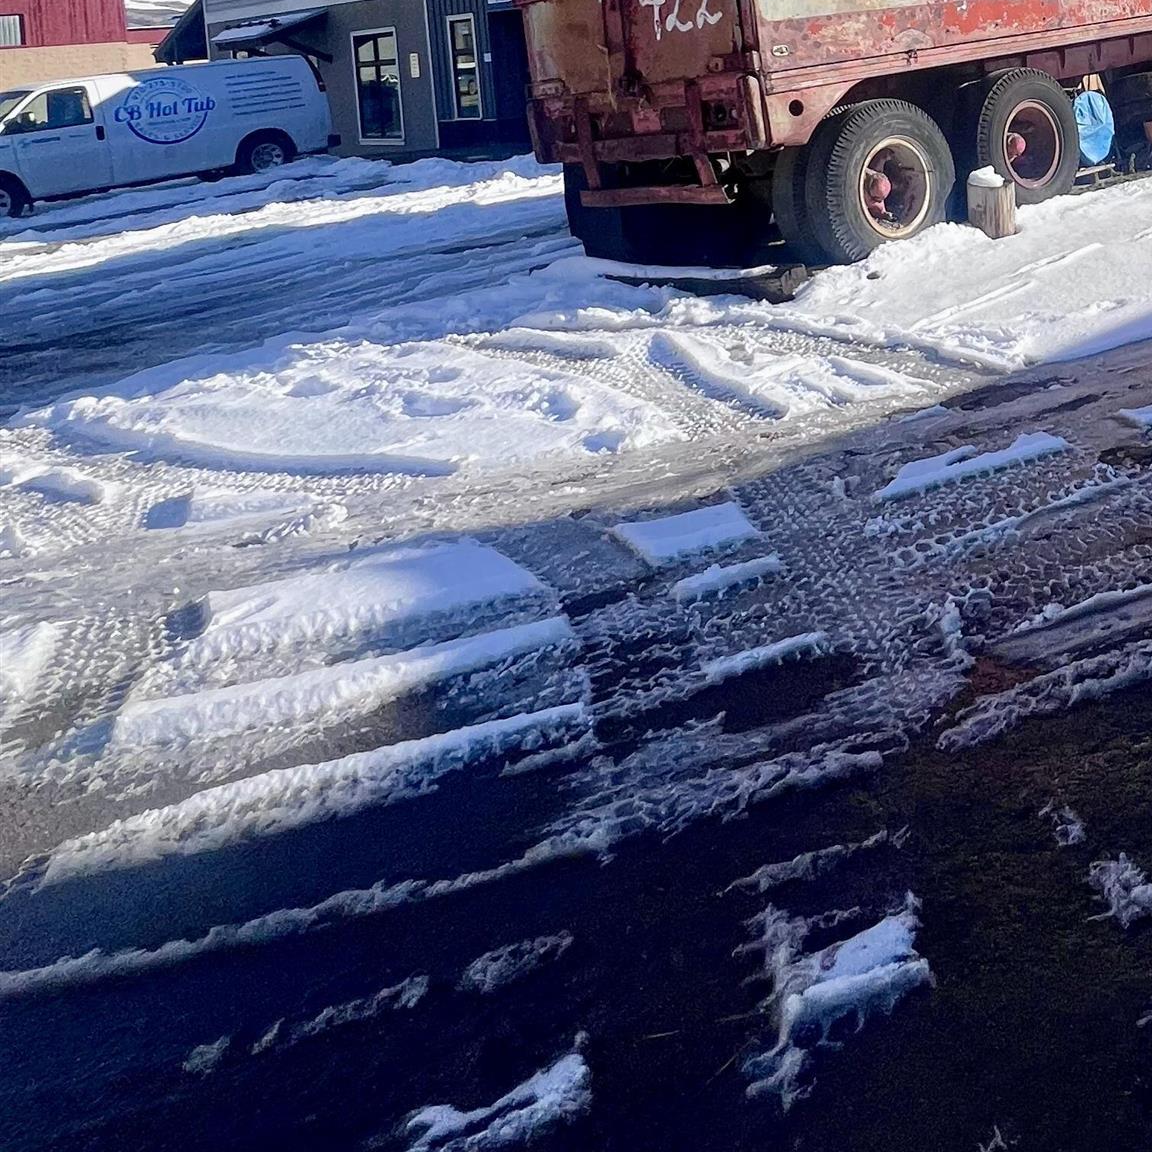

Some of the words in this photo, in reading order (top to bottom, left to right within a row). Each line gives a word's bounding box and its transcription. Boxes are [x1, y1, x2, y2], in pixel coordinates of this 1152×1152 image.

[114, 105, 142, 123] CB
[146, 101, 178, 119] Hot
[182, 96, 216, 114] Tub
